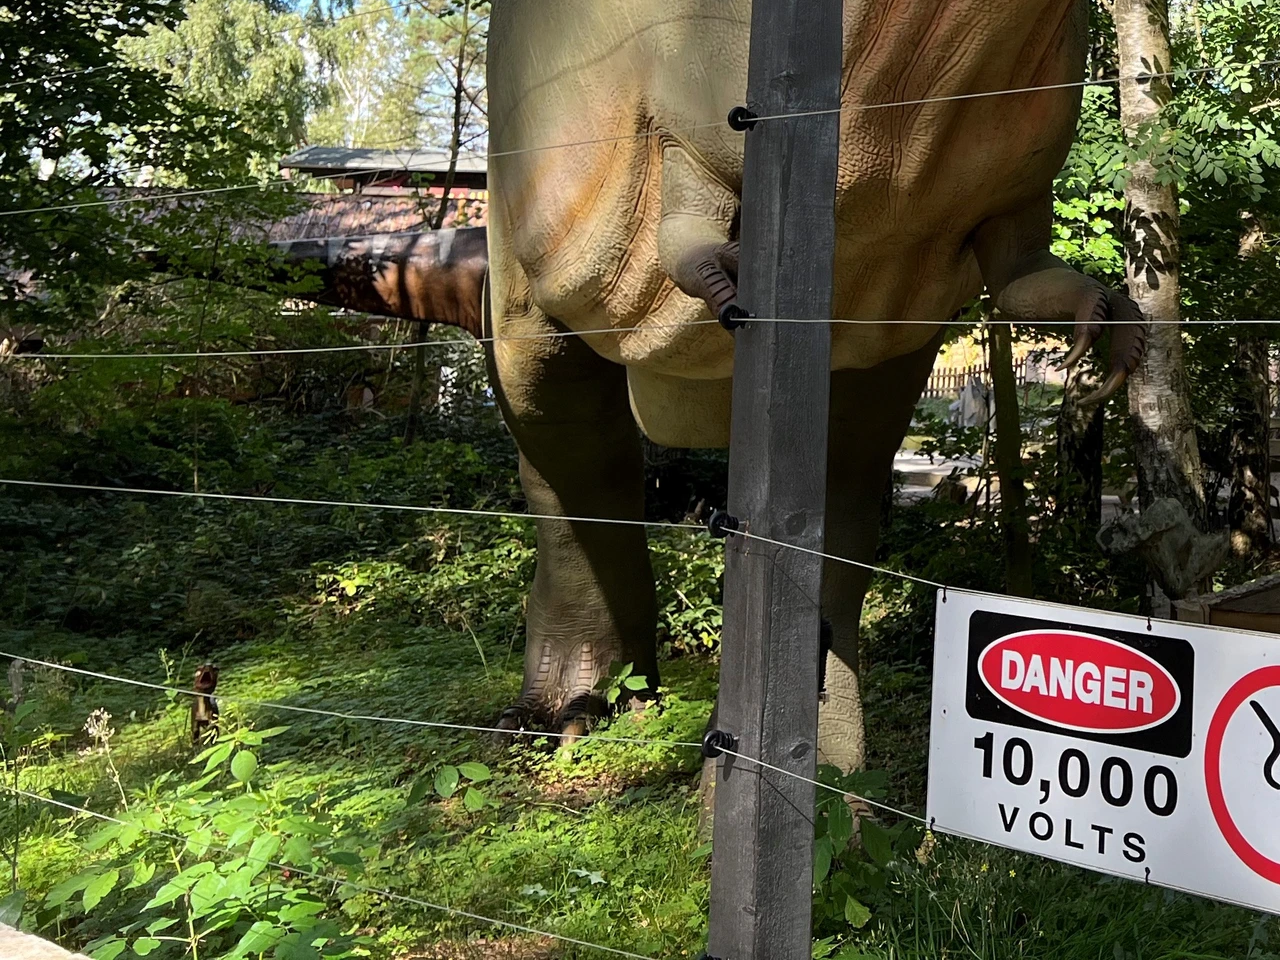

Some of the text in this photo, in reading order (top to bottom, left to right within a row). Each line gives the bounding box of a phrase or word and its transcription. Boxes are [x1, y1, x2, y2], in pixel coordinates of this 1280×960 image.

[1000, 649, 1154, 715] DANGER
[973, 731, 1179, 818] 10,000
[998, 802, 1147, 864] VOLTS
